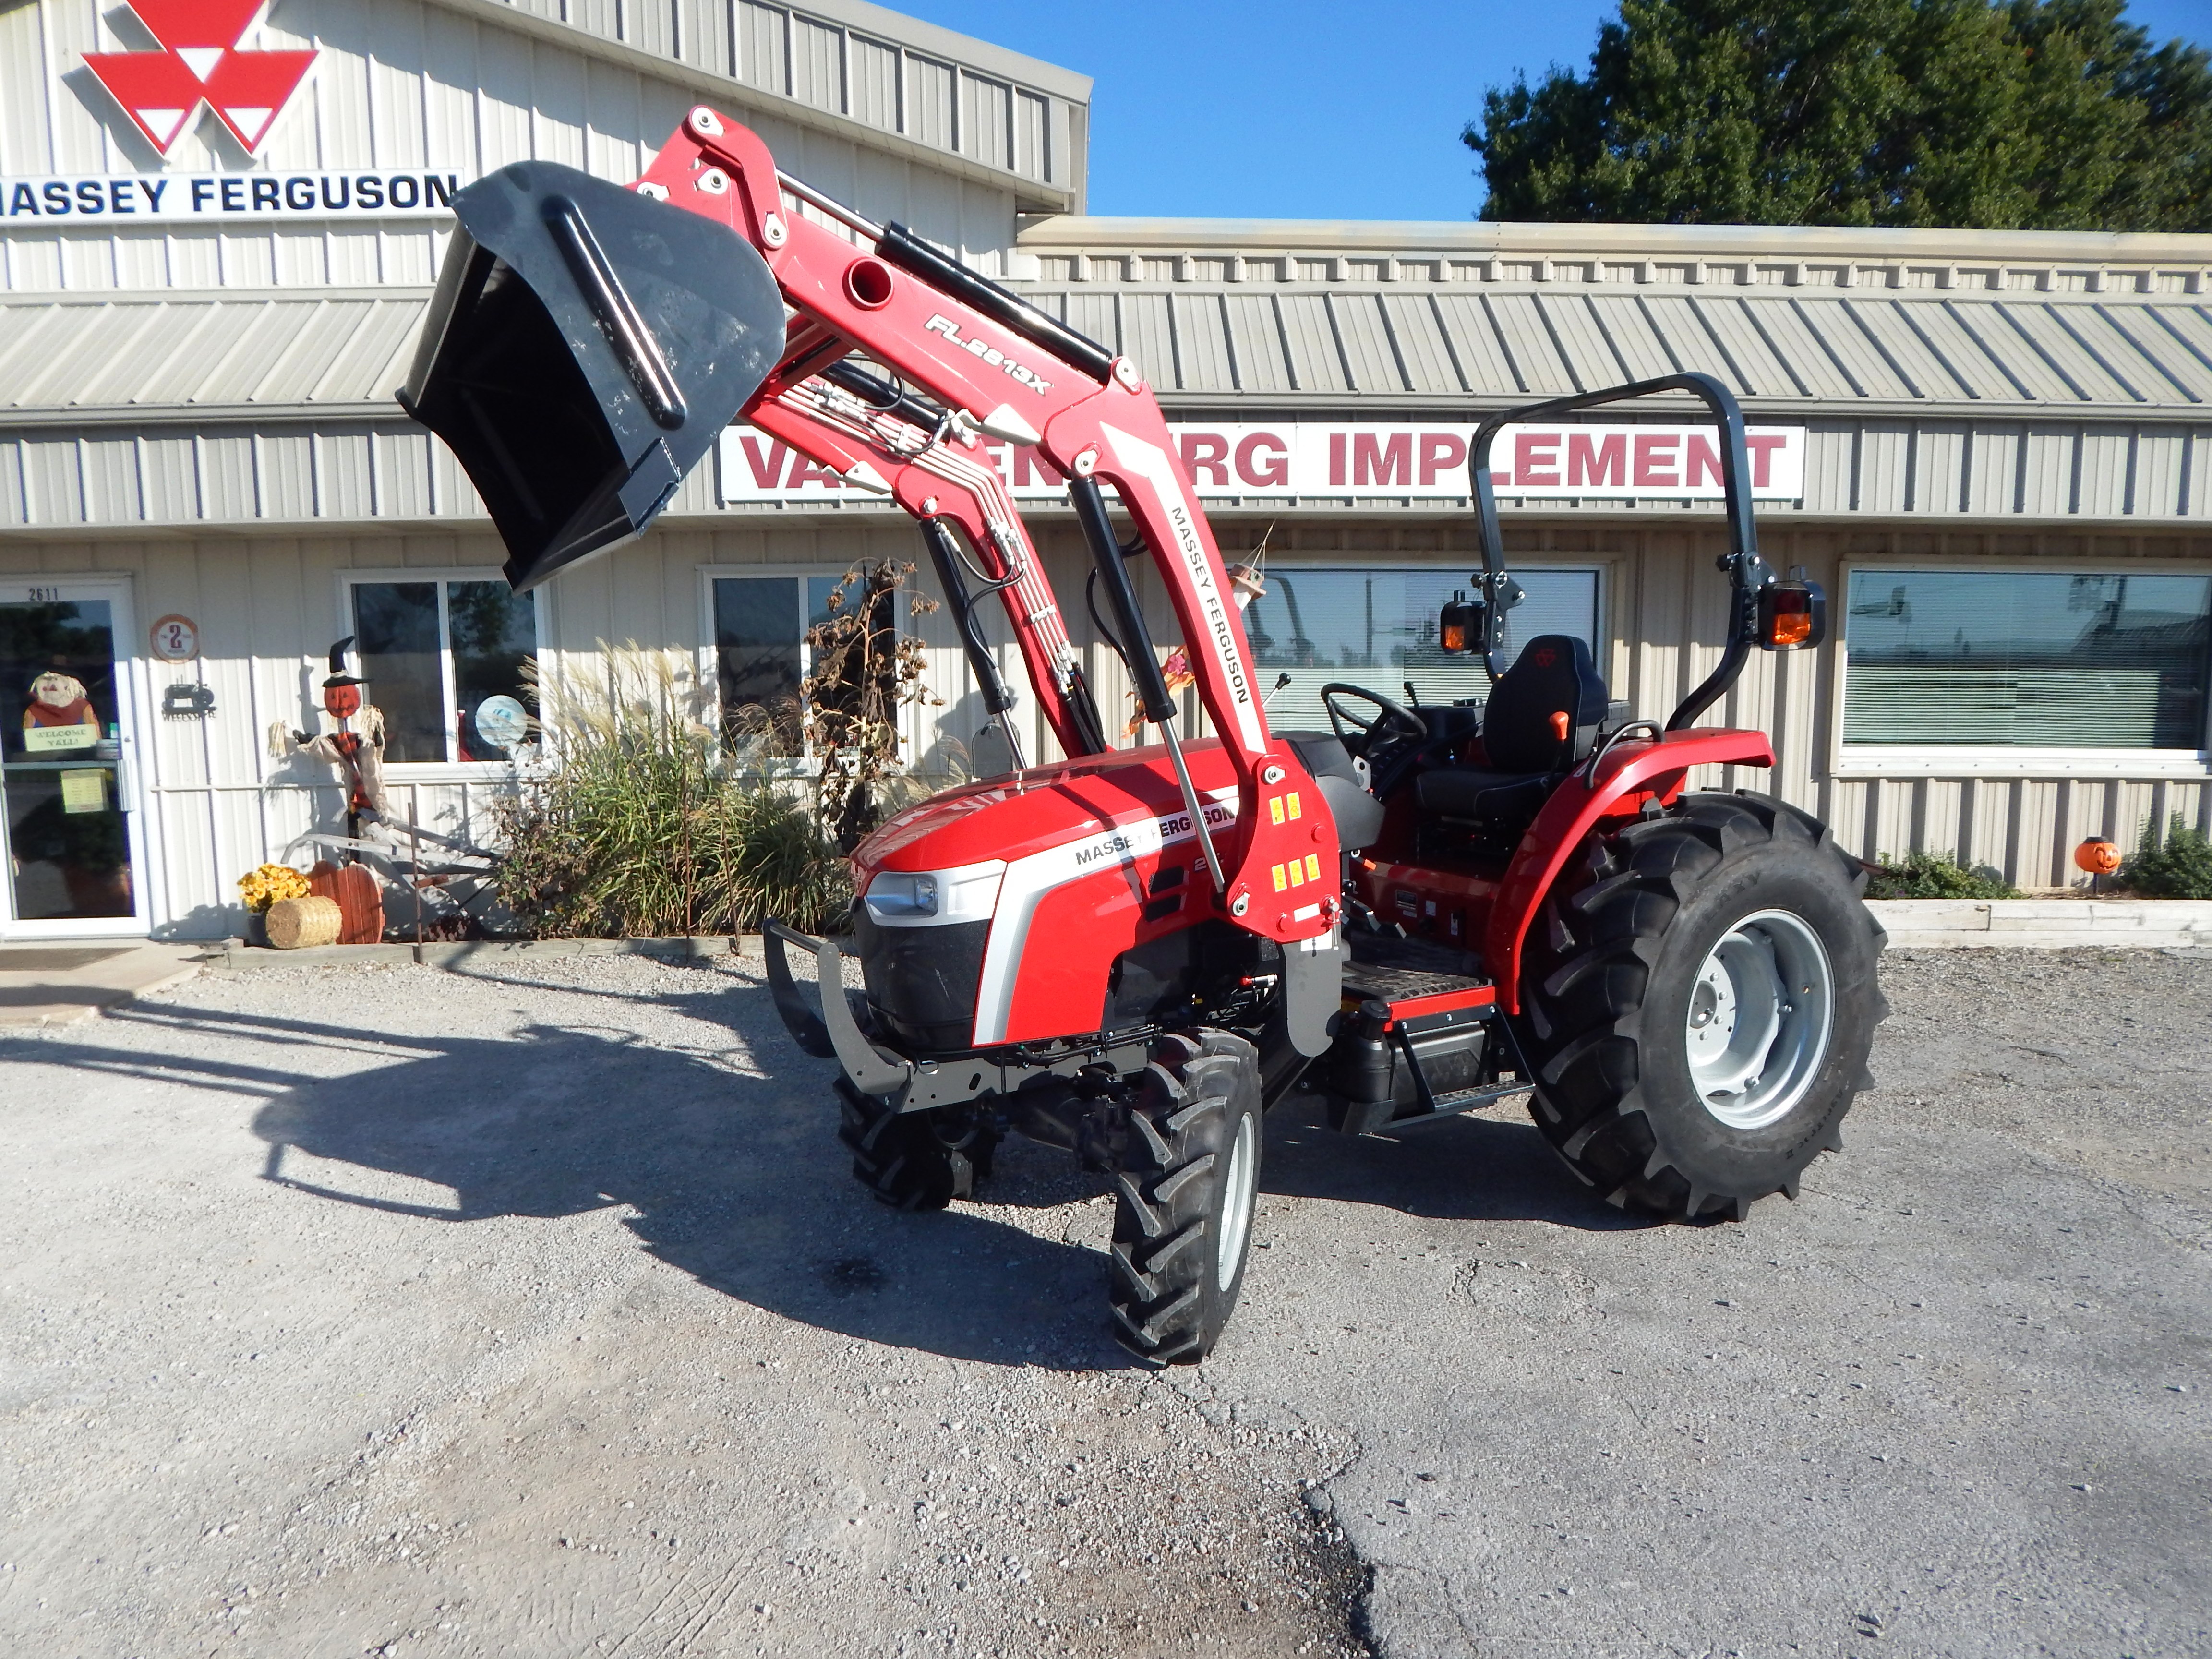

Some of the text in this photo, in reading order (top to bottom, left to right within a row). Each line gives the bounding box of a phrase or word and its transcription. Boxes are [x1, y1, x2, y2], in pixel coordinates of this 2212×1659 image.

[0, 174, 457, 216] ASSEY FERGUSON
[924, 313, 1052, 396] FL.2813X
[29, 588, 58, 601] 2611
[1172, 506, 1249, 704] MASSEY FERGUSON
[169, 625, 182, 648] 2
[35, 728, 87, 738] WELCOME
[1076, 807, 1235, 865] MASSEY FERGSON
